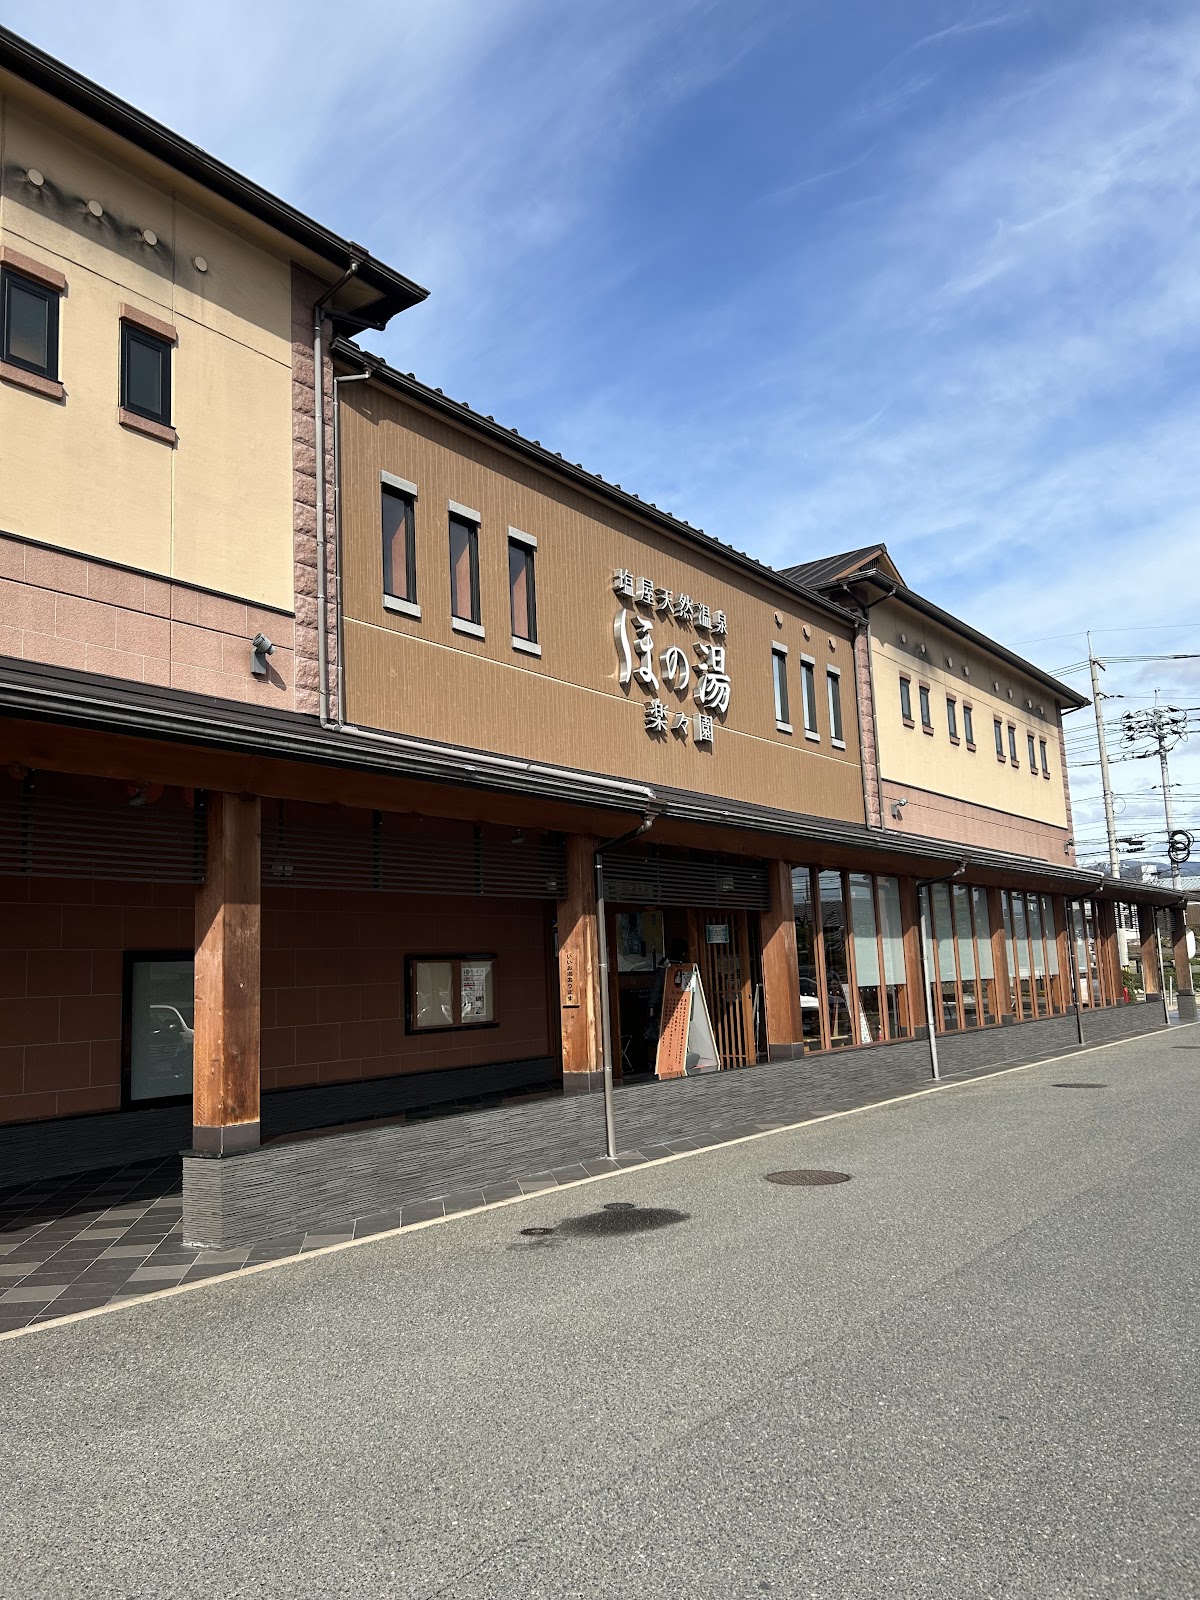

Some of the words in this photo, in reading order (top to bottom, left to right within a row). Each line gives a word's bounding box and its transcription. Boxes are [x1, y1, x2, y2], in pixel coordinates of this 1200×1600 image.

[613, 568, 728, 635] 塩屋天然温泉
[614, 608, 731, 713] ほの湯
[645, 699, 714, 743] 楽々園
